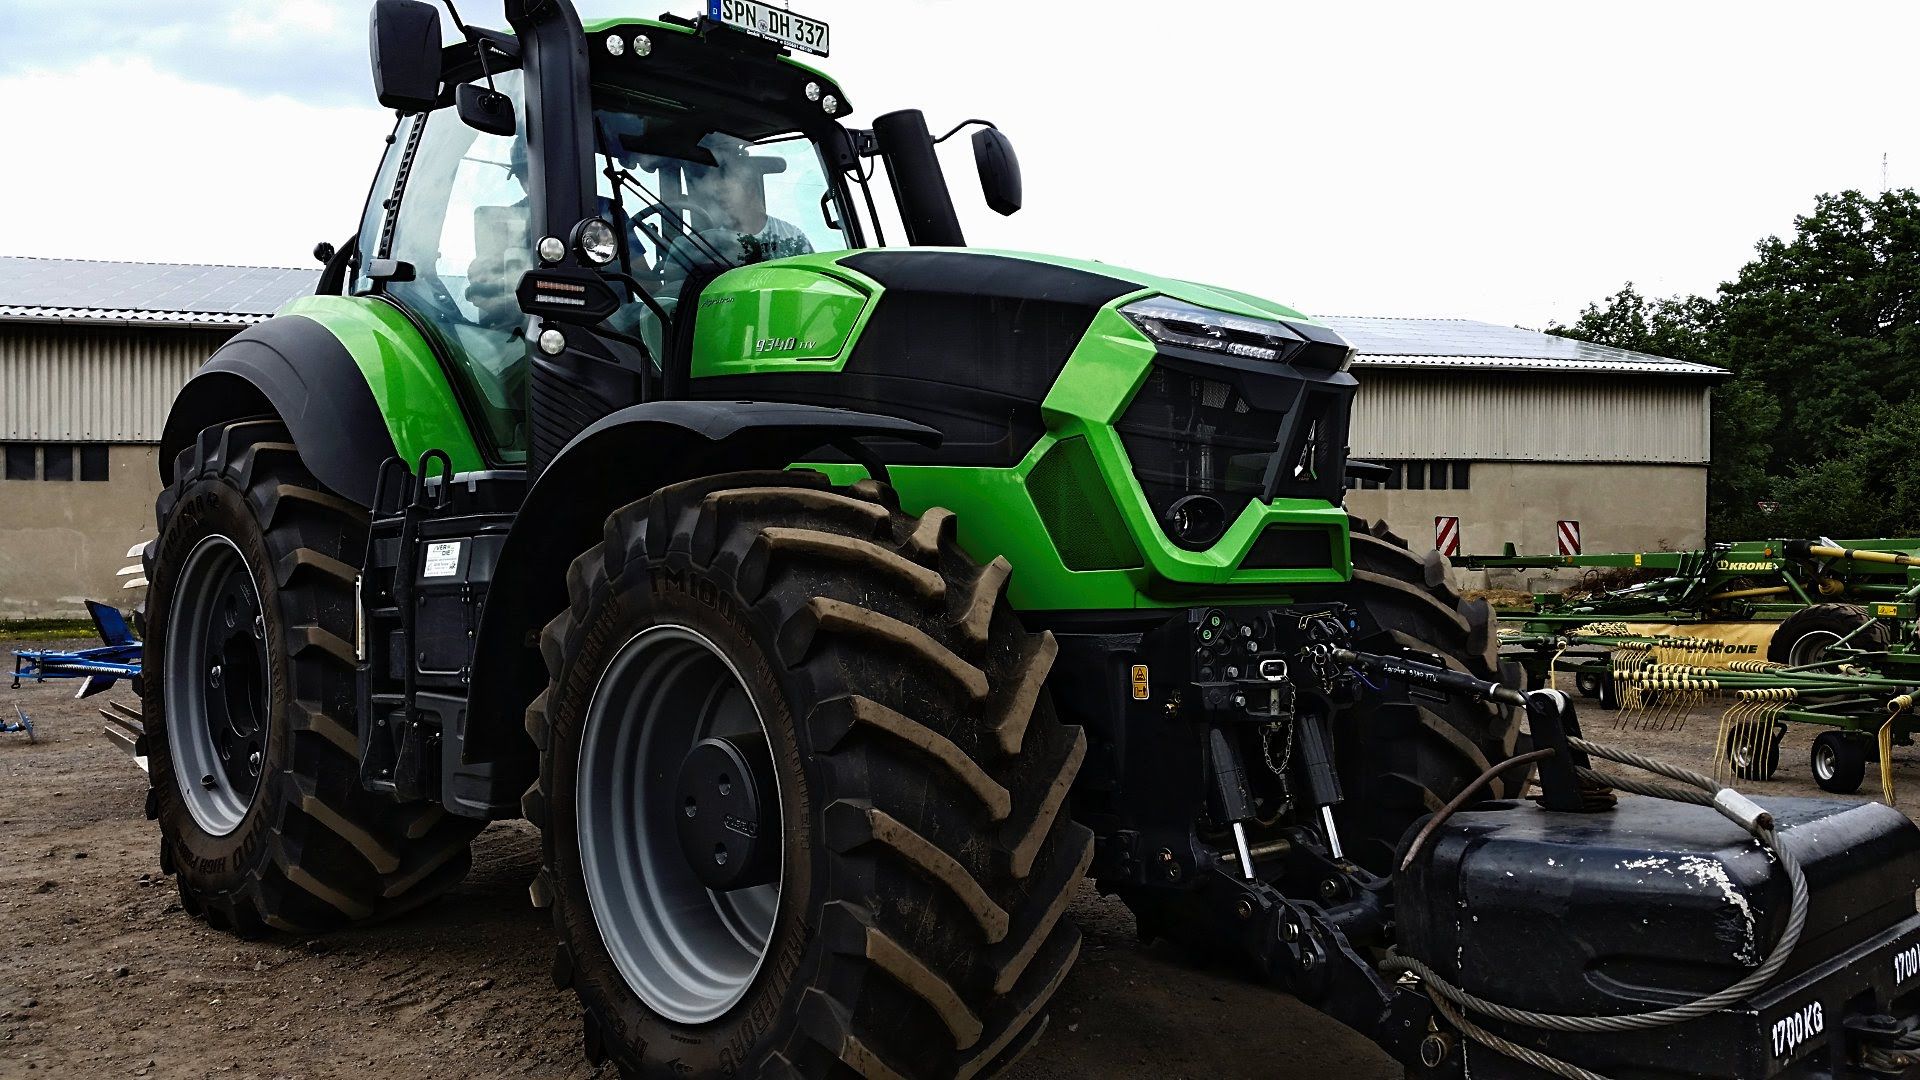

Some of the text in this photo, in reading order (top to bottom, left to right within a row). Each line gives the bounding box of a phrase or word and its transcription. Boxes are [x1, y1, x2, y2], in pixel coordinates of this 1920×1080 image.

[722, 0, 756, 28] SPN
[768, 10, 790, 38] DH
[794, 19, 825, 47] 337
[756, 337, 796, 352] 9340
[1728, 562, 1773, 571] KRONE
[1772, 1001, 1824, 1057] 1700KG
